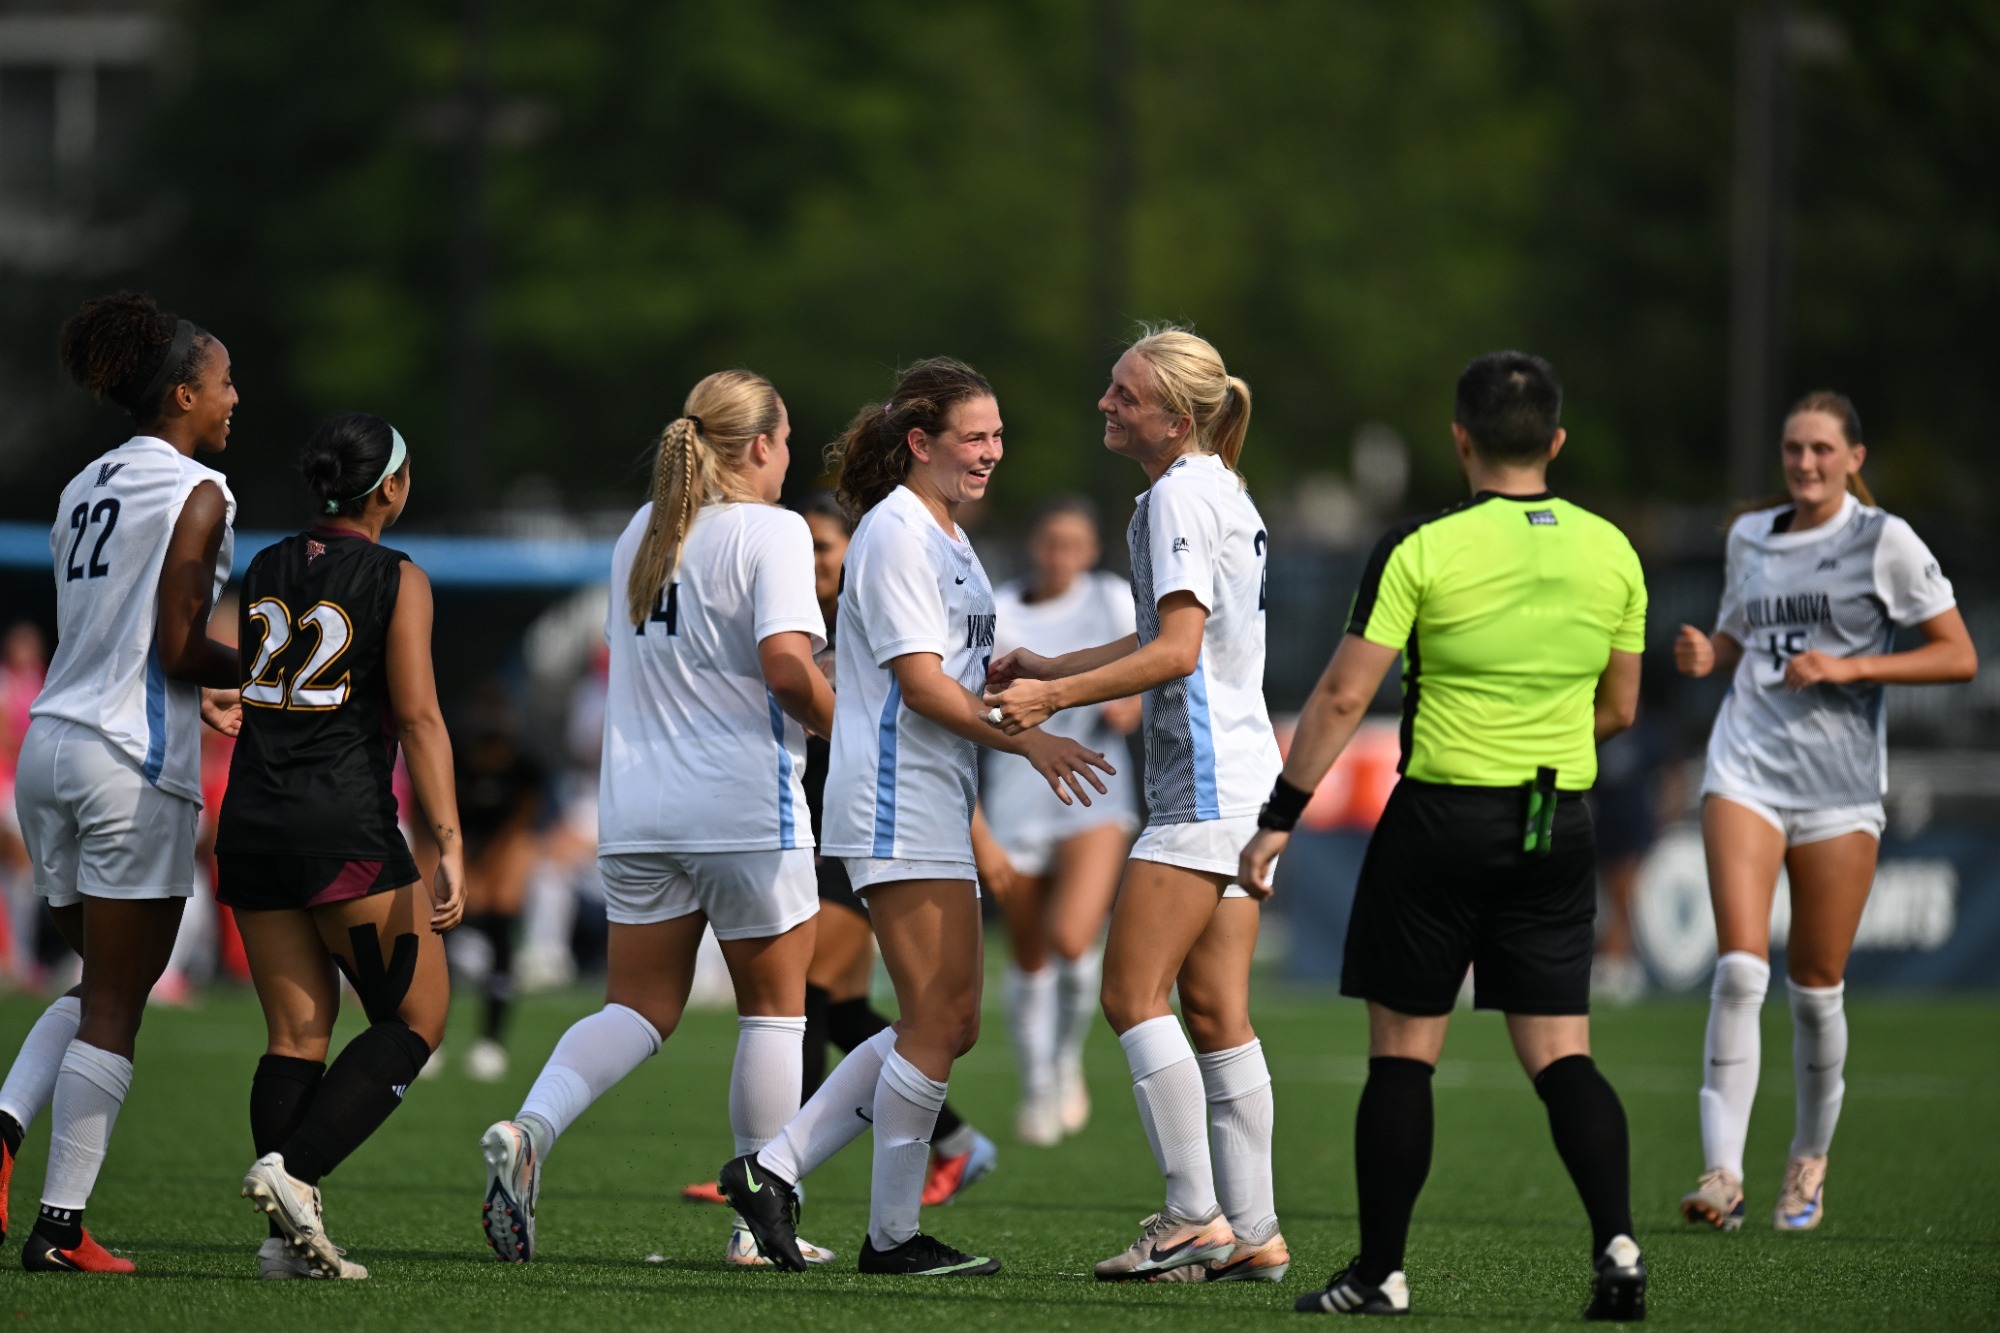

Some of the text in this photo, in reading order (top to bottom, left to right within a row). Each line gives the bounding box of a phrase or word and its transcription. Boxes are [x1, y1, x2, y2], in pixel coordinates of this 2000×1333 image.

[67, 498, 120, 583] 22
[636, 583, 679, 636] 4
[1748, 593, 1831, 626] VILLANOVA
[242, 597, 353, 709] 22
